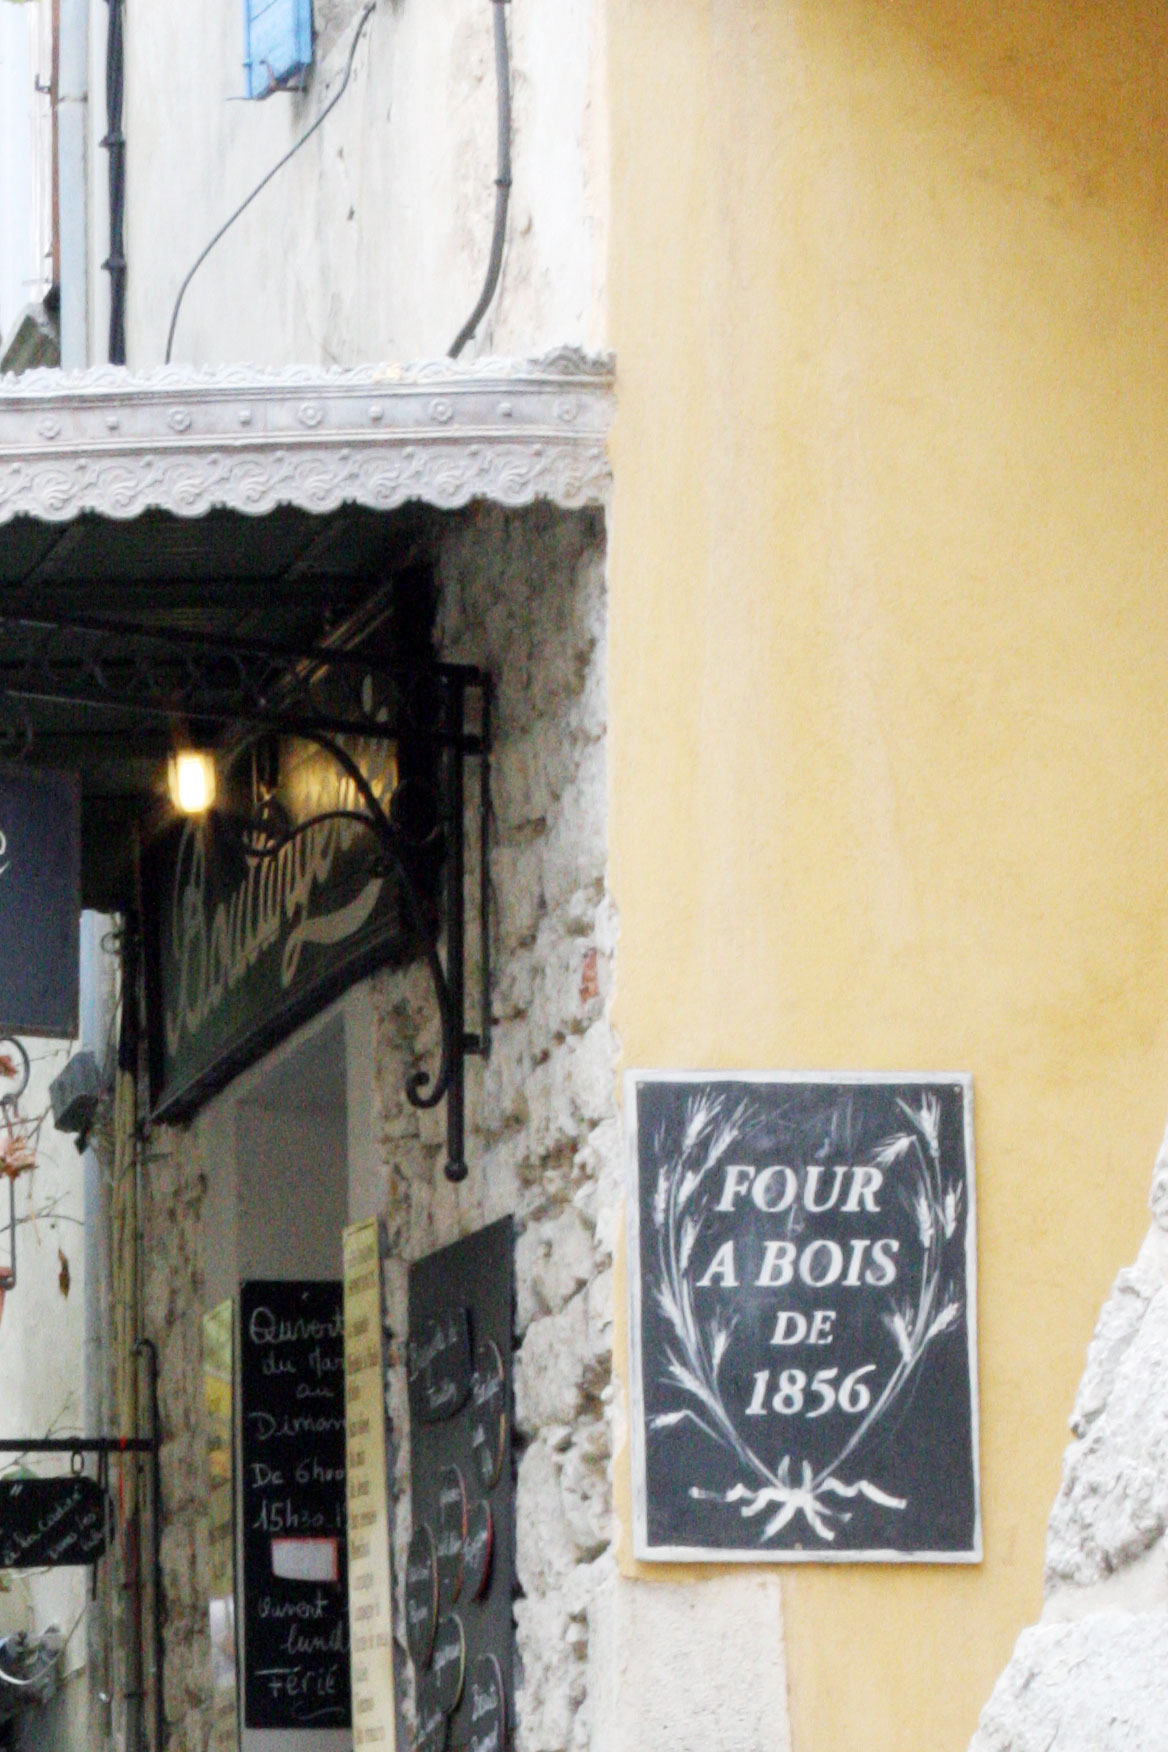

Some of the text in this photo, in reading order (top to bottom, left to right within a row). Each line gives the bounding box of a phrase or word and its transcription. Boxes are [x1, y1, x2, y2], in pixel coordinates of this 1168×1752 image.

[714, 1164, 884, 1213] FOUR
[696, 1238, 900, 1288] A BOIS
[770, 1310, 837, 1346] DE
[744, 1364, 877, 1418] 1856
